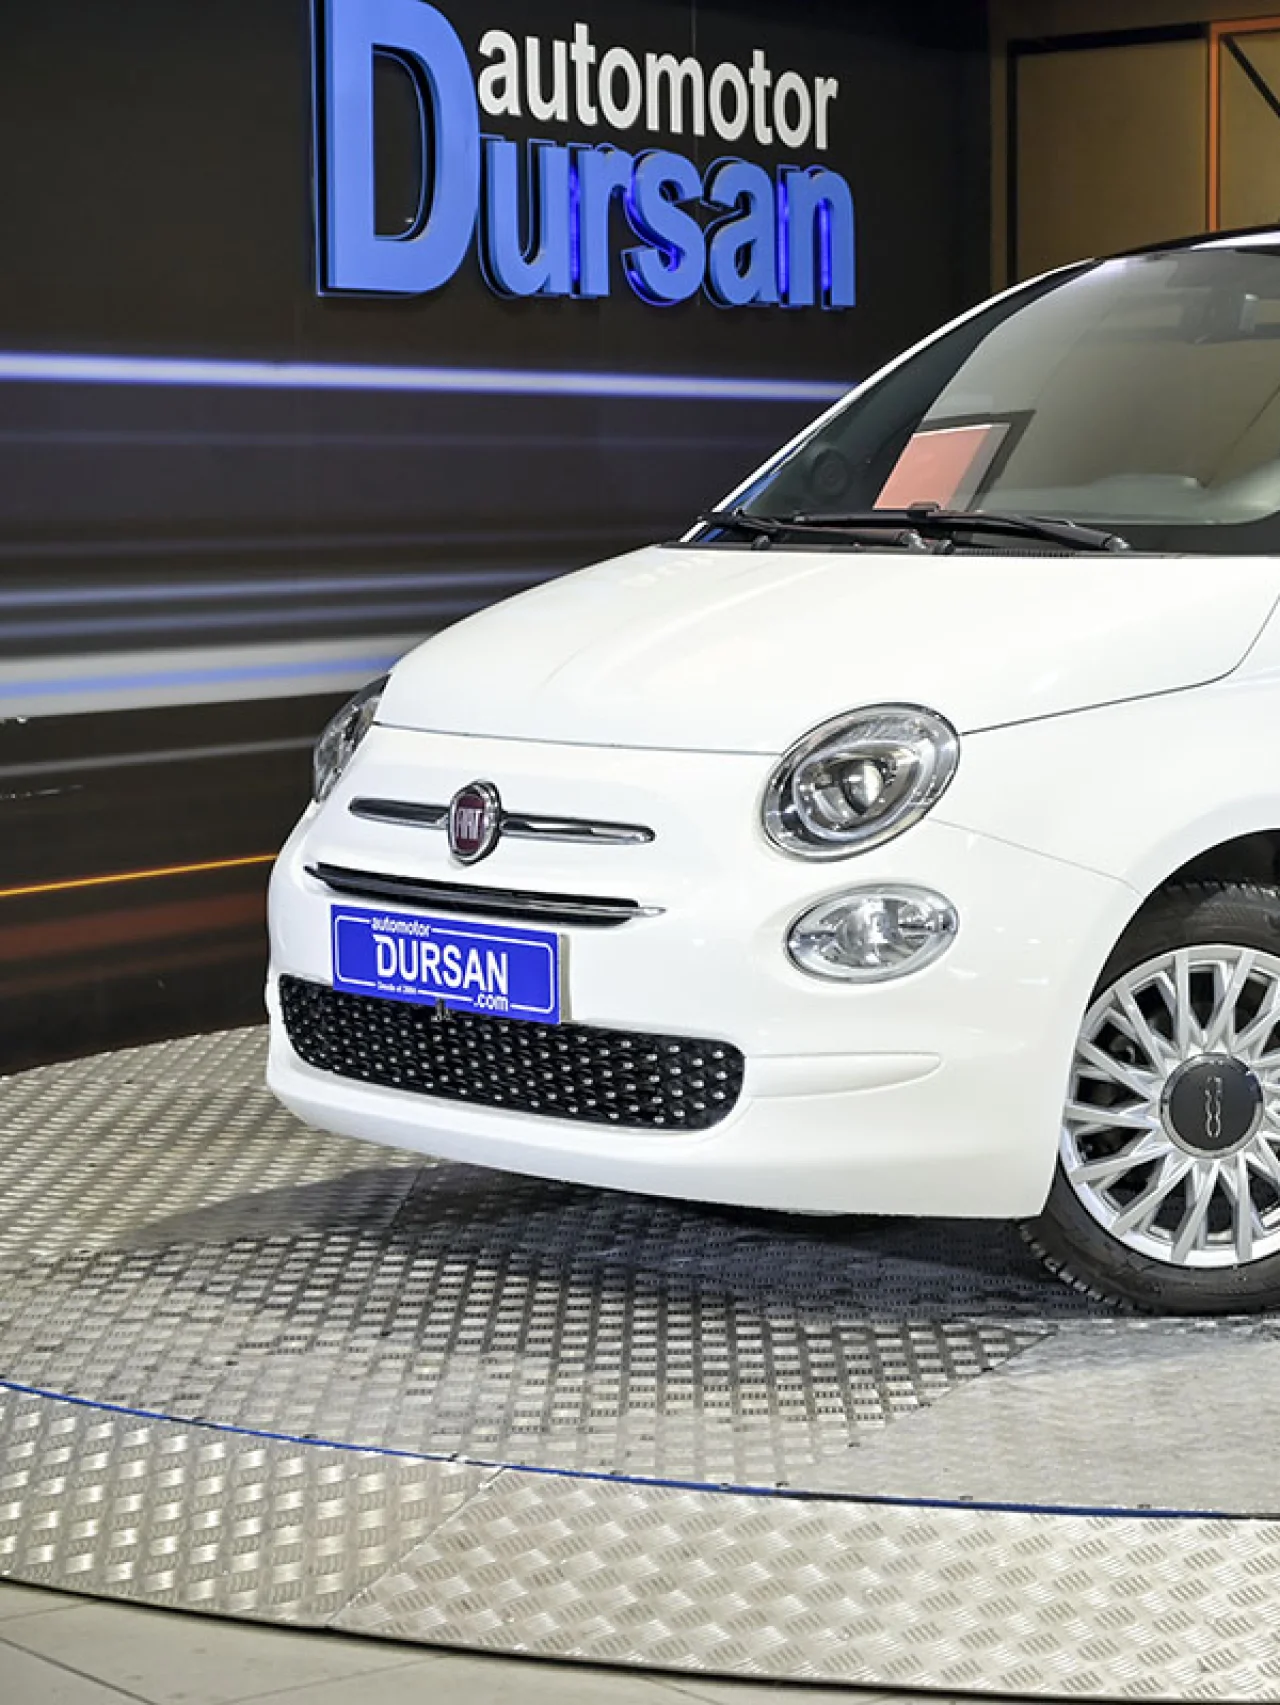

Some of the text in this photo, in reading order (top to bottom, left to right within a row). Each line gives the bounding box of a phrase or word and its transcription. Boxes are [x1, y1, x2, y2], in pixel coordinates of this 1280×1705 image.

[478, 22, 839, 150] automotor
[311, 0, 857, 310] Dursan
[455, 808, 483, 840] FIAT
[371, 916, 431, 938] automotor
[372, 934, 509, 996] DURSAN
[473, 992, 509, 1012] .com
